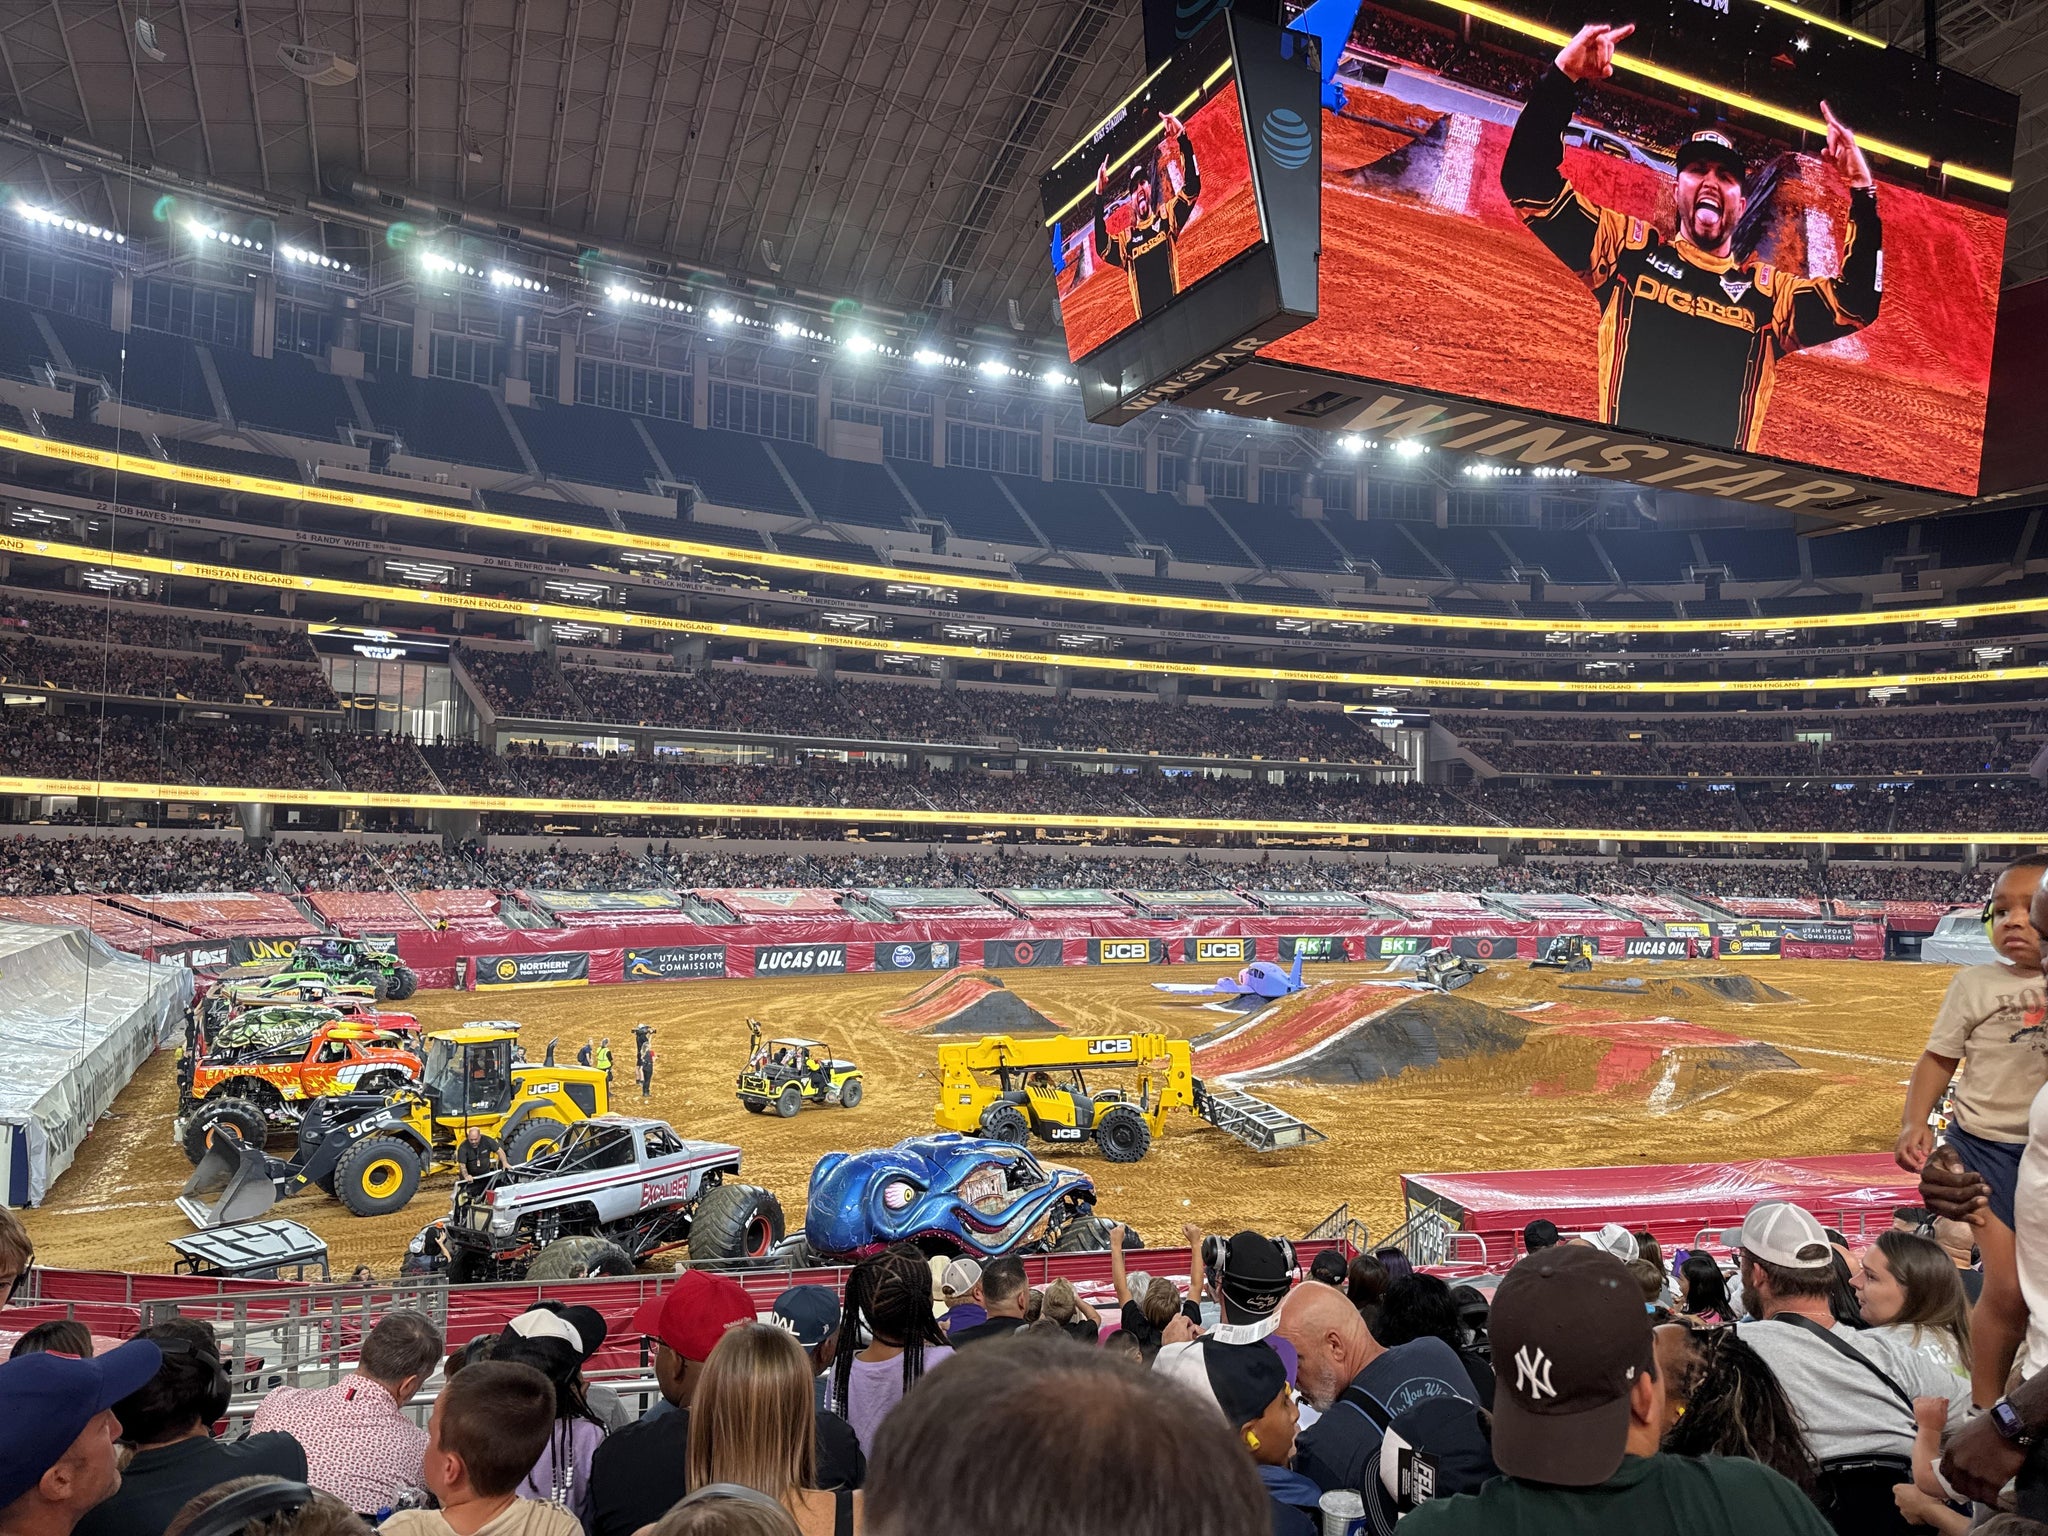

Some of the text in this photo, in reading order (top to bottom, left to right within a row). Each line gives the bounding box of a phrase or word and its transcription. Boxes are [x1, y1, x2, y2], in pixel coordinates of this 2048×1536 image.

[1093, 107, 1127, 144] AT&T STADIUM
[1695, 133, 1729, 148] JCB
[1646, 253, 1683, 279] JCB
[1121, 337, 1269, 411] WINSTAR
[1342, 395, 1856, 507] WINSTAR
[96, 502, 107, 511] 22
[112, 503, 134, 515] BOB
[135, 508, 167, 521] HAYES
[296, 532, 307, 540] 54
[311, 534, 341, 545] RANDY
[343, 539, 371, 548] WHITE
[483, 557, 494, 565] 20
[497, 559, 513, 567] MEL
[514, 561, 543, 571] RENFRO
[195, 566, 293, 586] TRISTAN ENGLAND
[653, 579, 675, 587] CHUCK
[676, 581, 703, 590] HOWLEY
[438, 595, 522, 611] TRISTAN ENGLAND
[800, 596, 814, 604] DON
[815, 598, 845, 607] MEREDITH
[640, 618, 713, 632] TRISTAN ENGLAND
[1064, 622, 1086, 630] PERKINS
[823, 636, 888, 648] TRISTAN ENGLAND
[1965, 638, 1994, 646] BRANDT
[988, 651, 1047, 661] TRISTAN ENGLAND
[1139, 663, 1165, 671] TRISTAN
[1914, 673, 1989, 683] TRISTAN ENGLAND
[1104, 944, 1146, 958] JCB
[1200, 943, 1241, 957] JCB
[1383, 939, 1416, 951] BKT
[1627, 942, 1666, 955] LUCAS
[192, 949, 227, 966] LOSI
[659, 952, 723, 962] UTAH SPORTS
[758, 951, 813, 970] LUCAS
[520, 961, 569, 971] NORTHERN
[659, 961, 723, 972] COMMISSION
[1089, 1040, 1131, 1053] JCB
[528, 1083, 560, 1095] JCB
[348, 1110, 393, 1139] JCB
[1052, 1129, 1081, 1139] JCB
[641, 1175, 689, 1208] EXCALIBER
[771, 1311, 801, 1337] DAL
[1514, 1345, 1557, 1399] NY
[1401, 1382, 1448, 1407] You Wi
